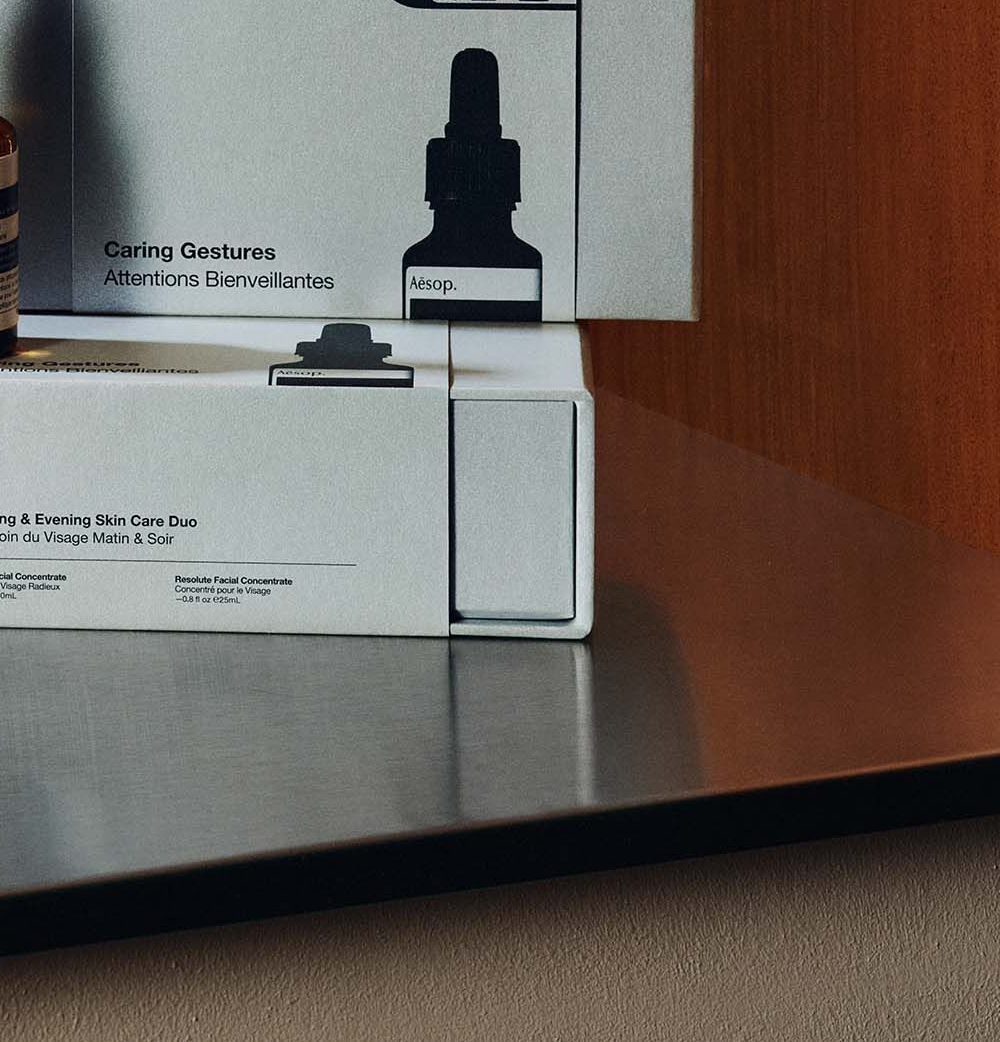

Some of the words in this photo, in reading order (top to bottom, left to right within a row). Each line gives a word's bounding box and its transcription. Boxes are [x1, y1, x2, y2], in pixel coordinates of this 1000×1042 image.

[104, 241, 174, 262] Caring
[180, 242, 276, 261] Gestures
[103, 269, 200, 288] Attentions
[205, 270, 335, 290] Bienveillantes
[409, 275, 457, 295] Aēsop.
[65, 366, 199, 374] Bienveillantes
[20, 513, 31, 526] &
[34, 513, 91, 528] Evening
[95, 513, 127, 527] Skin
[130, 515, 165, 528] Care
[168, 515, 198, 528] Duo
[22, 530, 40, 543] du
[43, 531, 89, 546] Visage
[92, 532, 130, 545] Matin
[133, 532, 144, 545] &
[147, 532, 175, 546] Soir
[14, 572, 67, 581] Concentrate
[174, 575, 212, 584] Resolute
[213, 576, 239, 584] Facial
[240, 576, 293, 586] Concentrate
[0, 581, 27, 592] Visage
[28, 582, 61, 591] Radieux
[174, 584, 215, 594] Concentré
[216, 587, 235, 595] pour
[236, 586, 243, 594] le
[244, 586, 272, 597] Visage
[195, 595, 200, 603] fl
